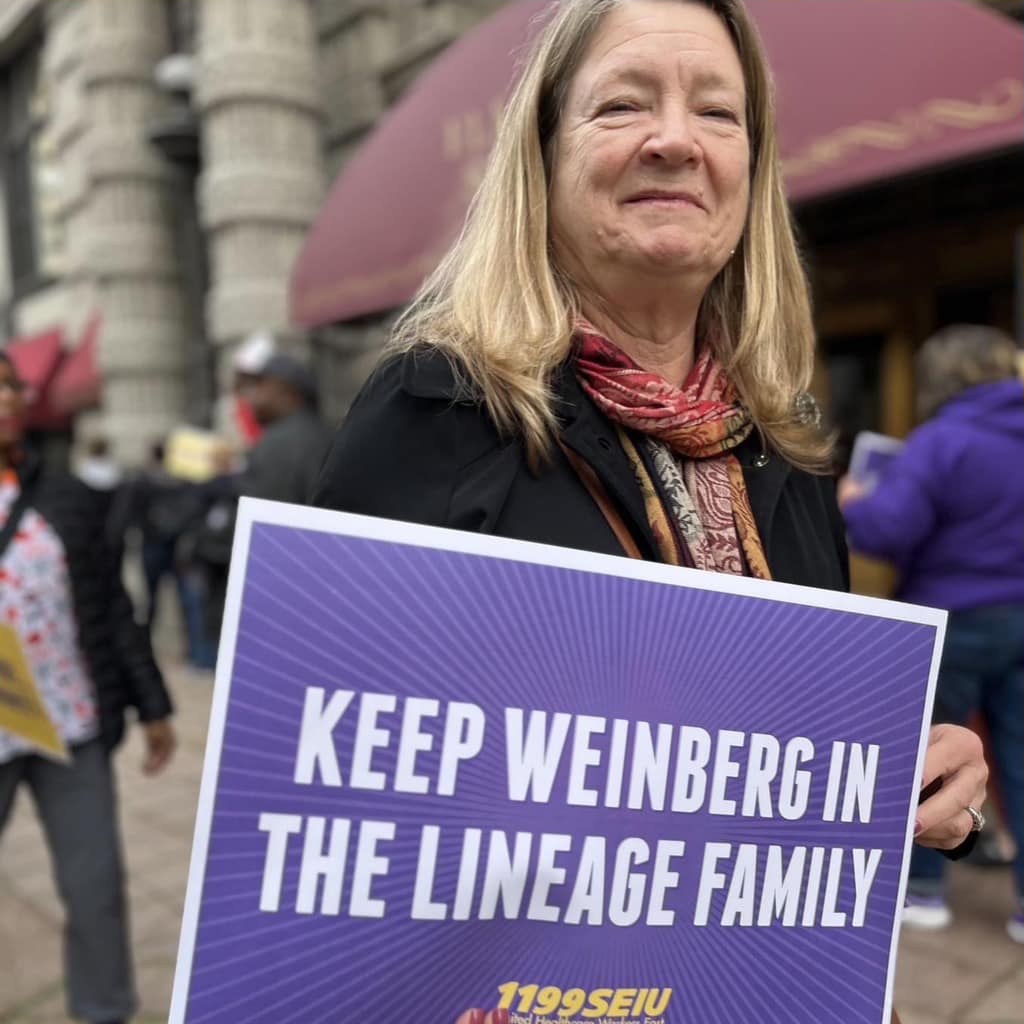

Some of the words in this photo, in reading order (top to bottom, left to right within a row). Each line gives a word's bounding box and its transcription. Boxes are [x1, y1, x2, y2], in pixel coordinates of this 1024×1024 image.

[294, 686, 485, 797] KEEP
[505, 707, 815, 824] WEINBERG
[822, 740, 881, 825] IN
[258, 812, 397, 920] THE
[410, 825, 687, 928] LINEAGE
[693, 841, 883, 929] FAMILY
[497, 981, 673, 1018] 1199SEIU
